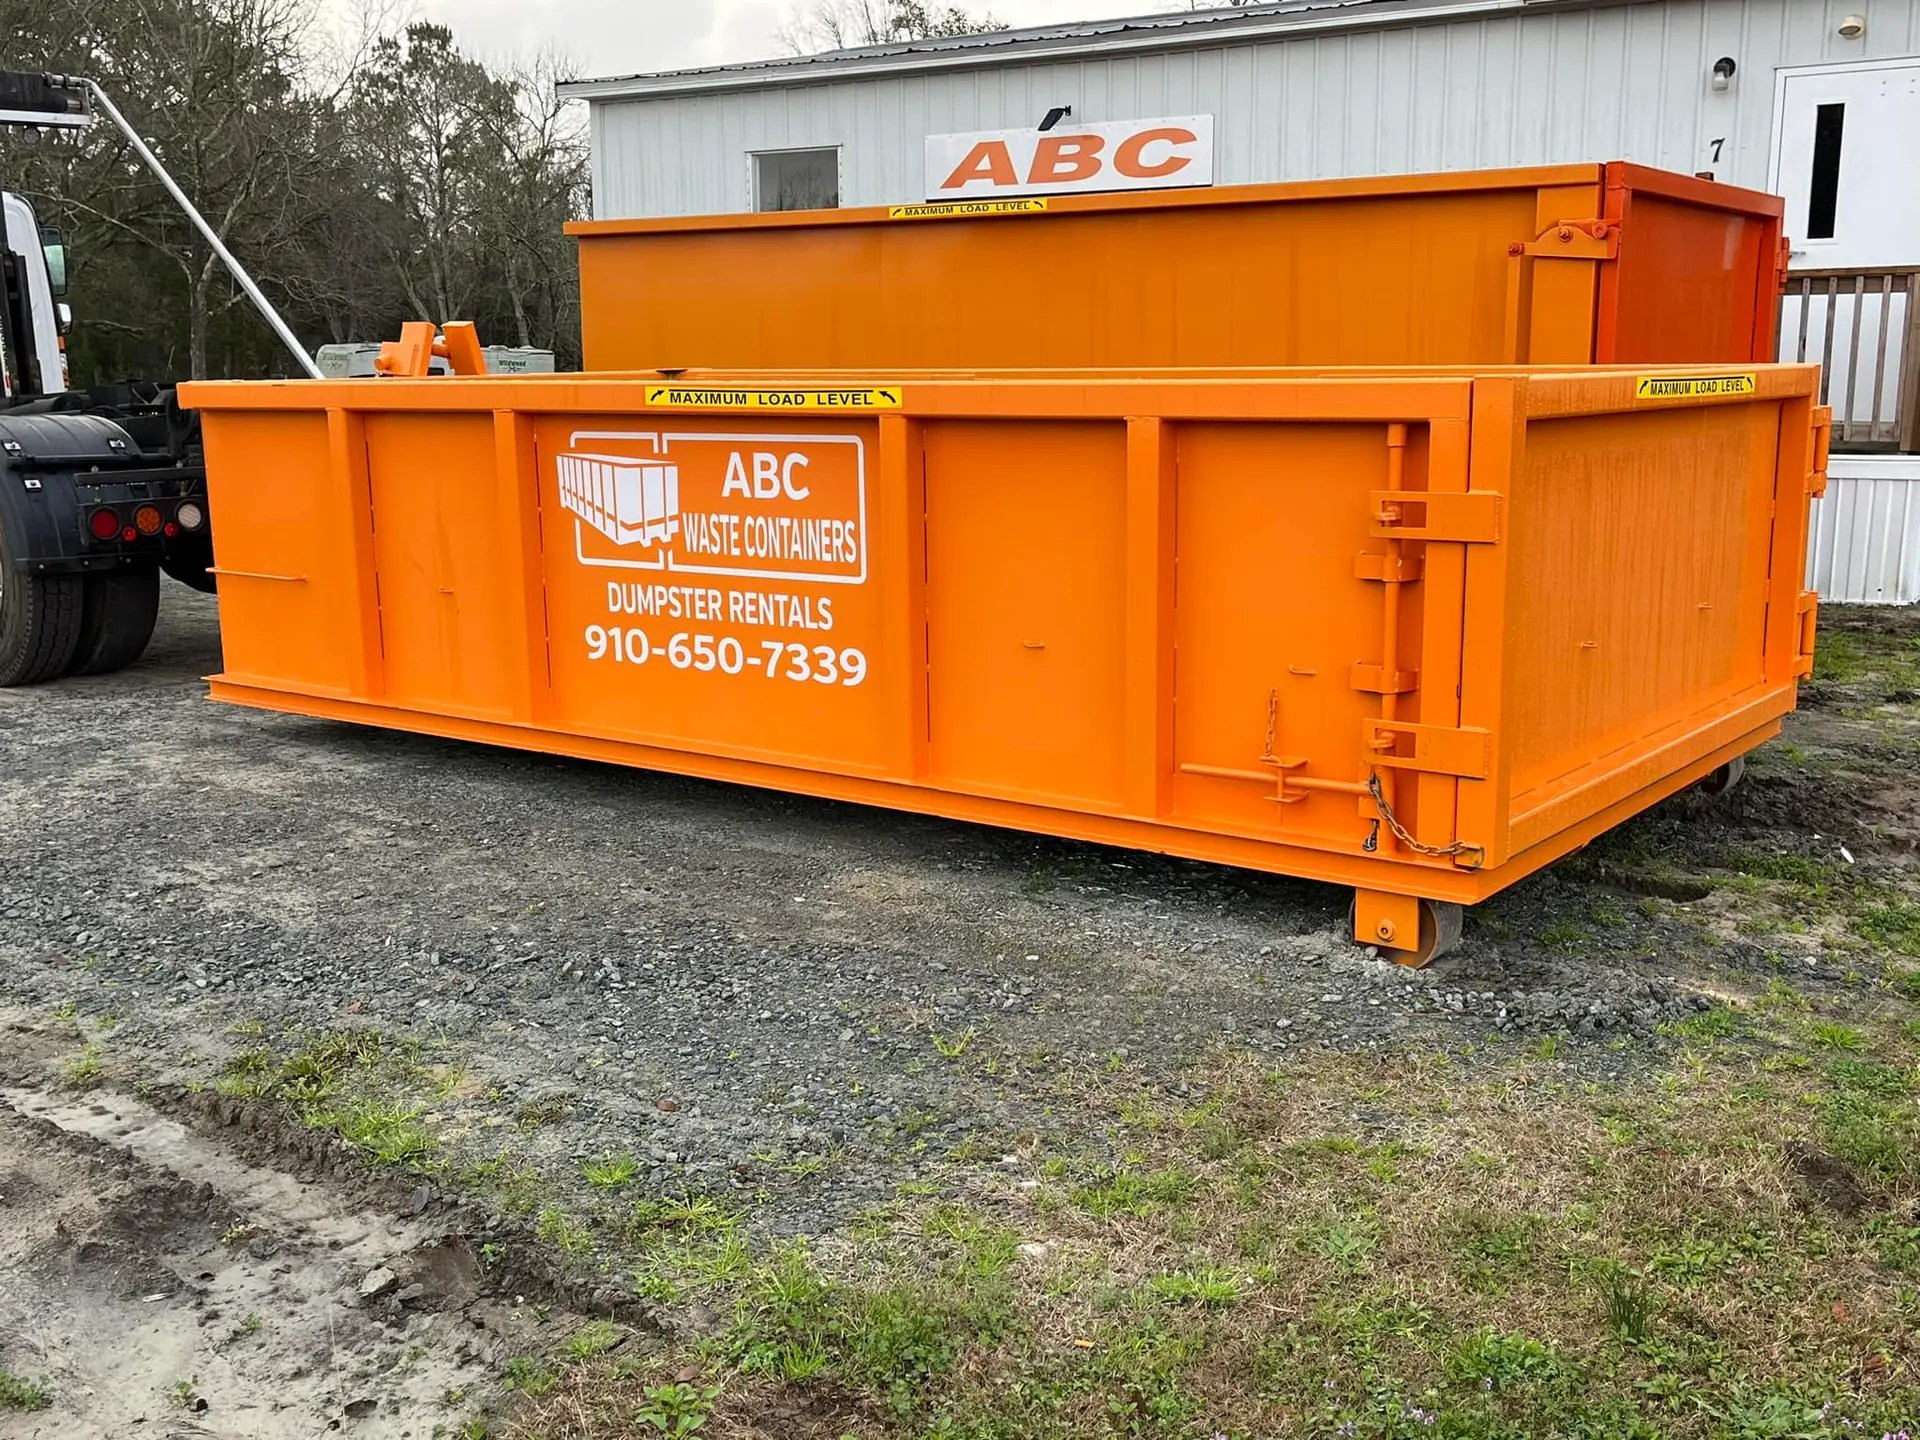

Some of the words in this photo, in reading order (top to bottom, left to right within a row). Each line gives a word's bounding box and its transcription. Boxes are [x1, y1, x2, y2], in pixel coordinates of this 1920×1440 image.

[940, 128, 1197, 189] ABC
[1710, 137, 1726, 163] 7
[904, 205, 954, 216] MAXIMUM
[960, 204, 990, 213] LOAD
[996, 202, 1030, 211] LEVEL
[669, 391, 748, 406] MAXIMUM
[758, 392, 806, 406] LOAD
[817, 392, 874, 406] LEVEL
[1650, 382, 1691, 395] MAXIMUM
[1696, 381, 1718, 393] LOAD
[1722, 380, 1745, 392] LEVEL
[721, 451, 810, 500] ABC
[683, 513, 740, 555] WASTE
[745, 514, 857, 564] CONTAINERS
[607, 582, 722, 621] DUMPSTER
[729, 590, 834, 631] RENTALS
[584, 624, 867, 687] 910-650-7339
